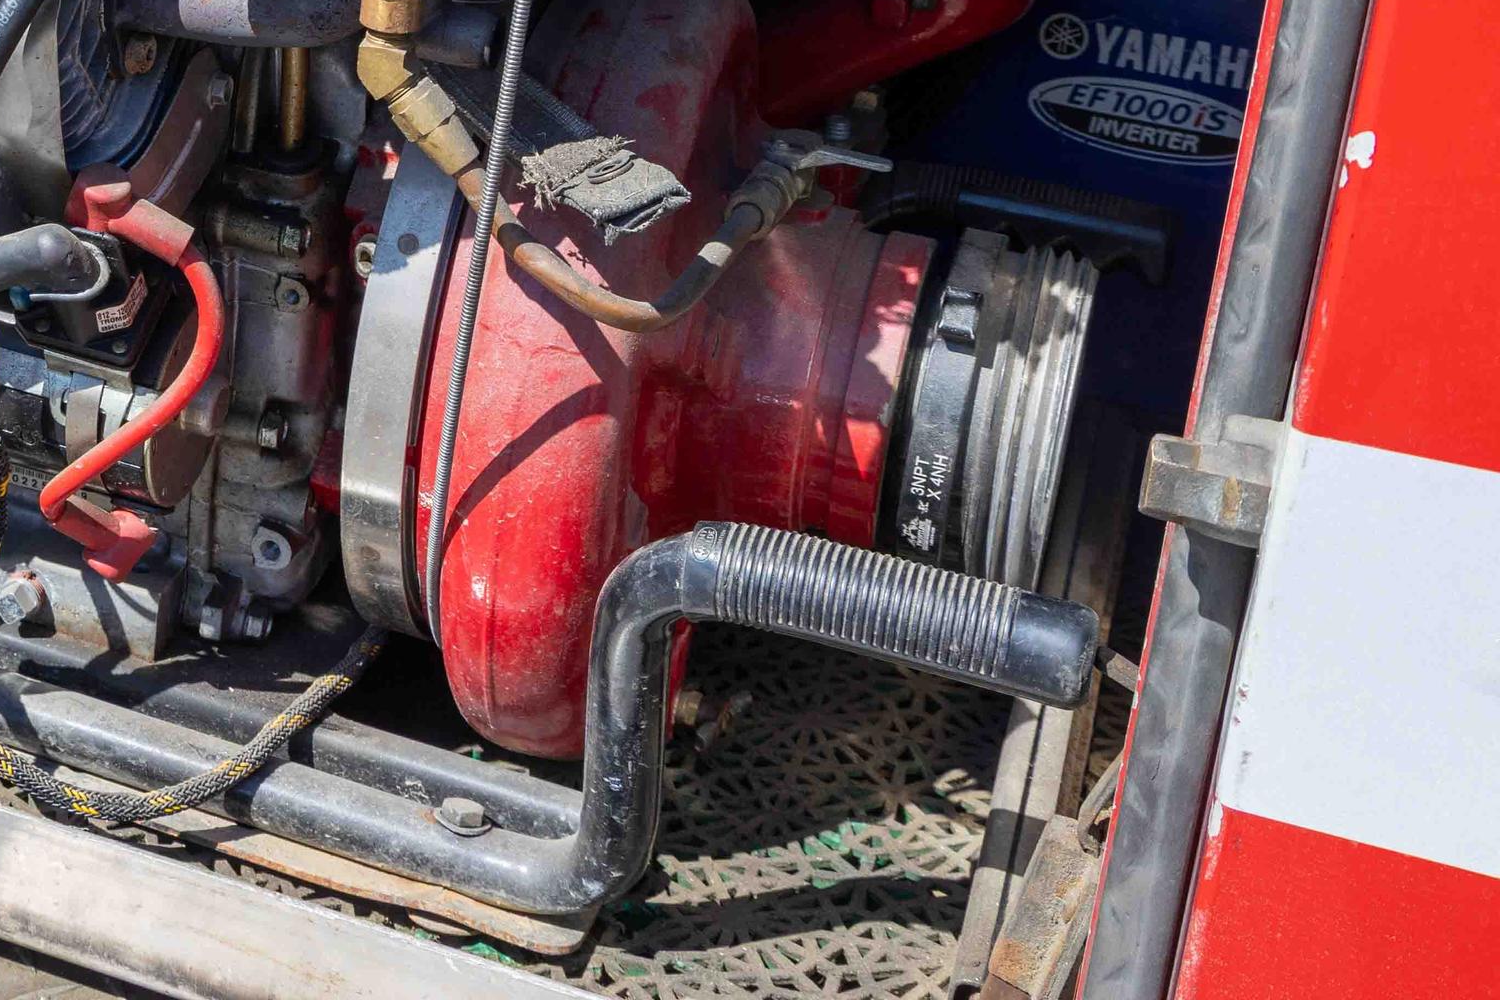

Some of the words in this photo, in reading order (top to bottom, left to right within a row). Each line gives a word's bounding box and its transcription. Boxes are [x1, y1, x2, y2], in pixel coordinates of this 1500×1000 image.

[1095, 22, 1250, 89] YAMAH
[1088, 116, 1200, 153] INVERTER
[910, 455, 930, 497] 3NPT
[929, 453, 949, 487] 4NH
[926, 488, 942, 501] X
